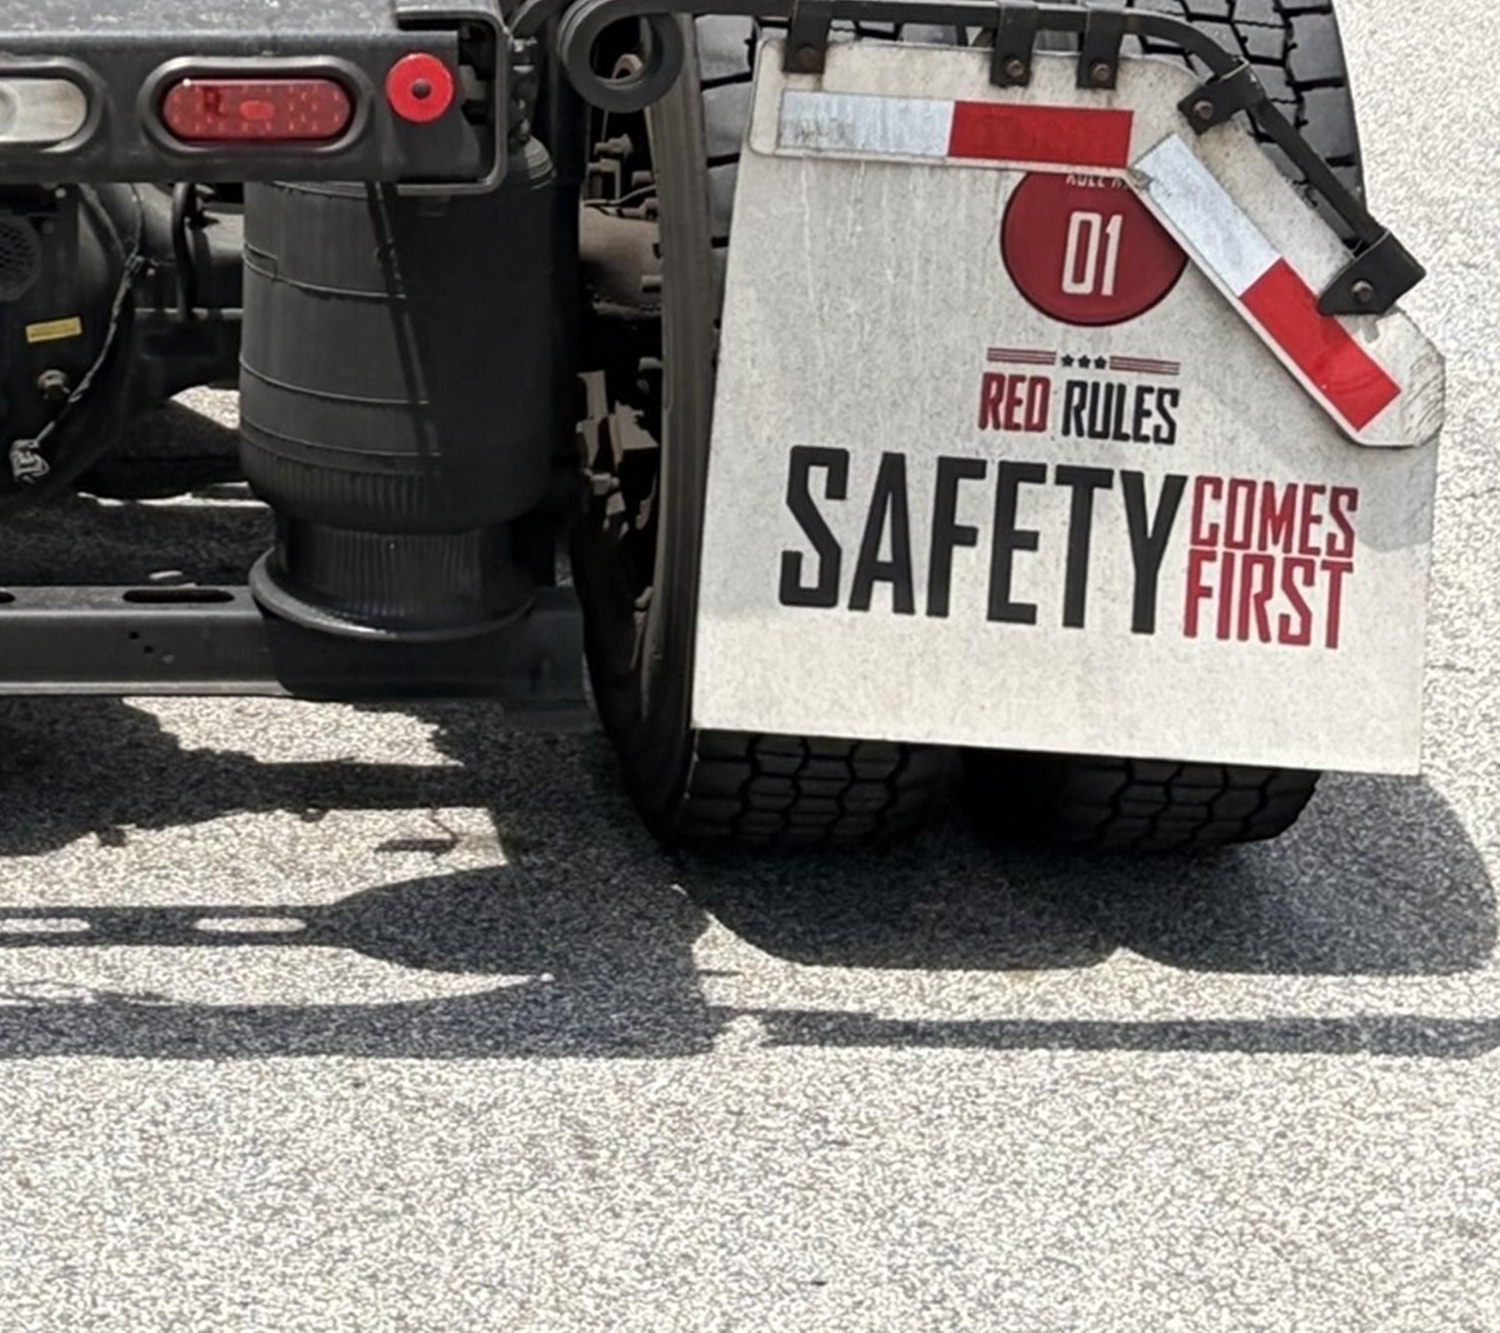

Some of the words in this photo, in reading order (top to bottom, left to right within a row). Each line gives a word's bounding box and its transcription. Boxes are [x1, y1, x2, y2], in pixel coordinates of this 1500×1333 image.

[1061, 210, 1123, 296] 01
[978, 372, 1051, 432] RED
[1061, 379, 1180, 446] RULES
[778, 444, 1188, 635] SAFETY
[1191, 474, 1360, 559] COMES
[1182, 548, 1355, 650] FIRST
